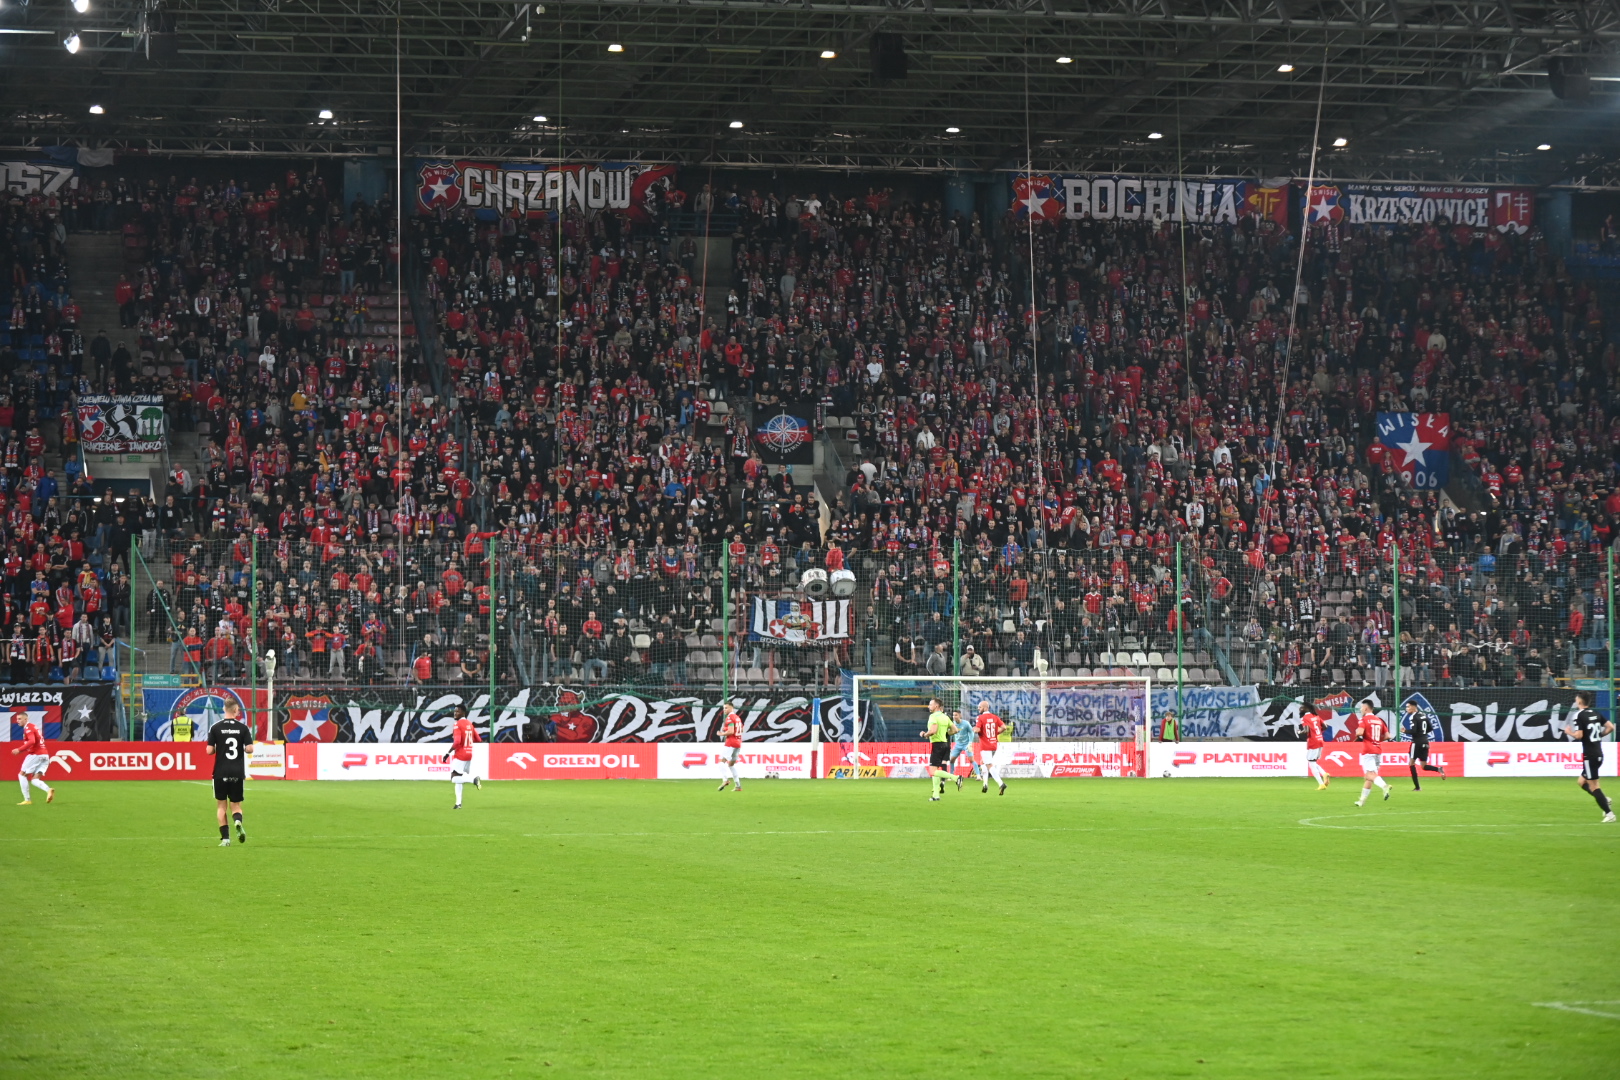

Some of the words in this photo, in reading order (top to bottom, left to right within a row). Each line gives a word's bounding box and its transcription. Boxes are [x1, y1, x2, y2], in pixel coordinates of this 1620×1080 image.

[0, 162, 79, 198] SZ
[1063, 178, 1238, 225] BOCHNIA
[1349, 193, 1489, 228] KRZESZOWICE
[1379, 412, 1449, 438] WISŁA
[1400, 470, 1438, 488] 906
[1180, 716, 1234, 737] RAWA!
[1313, 720, 1321, 735] 5
[1370, 724, 1382, 742] 10
[1422, 720, 1428, 735] 9
[225, 737, 239, 760] 3
[94, 756, 148, 767] ORLEN
[156, 752, 196, 770] OIL
[375, 755, 455, 765] PLATINU
[547, 757, 596, 766] ORLEN
[602, 754, 640, 768] OIL
[715, 754, 803, 764] PATINUM
[881, 756, 928, 765] ORLEN
[1203, 753, 1287, 763] PLATINUM
[1517, 753, 1585, 763] PLATINU
